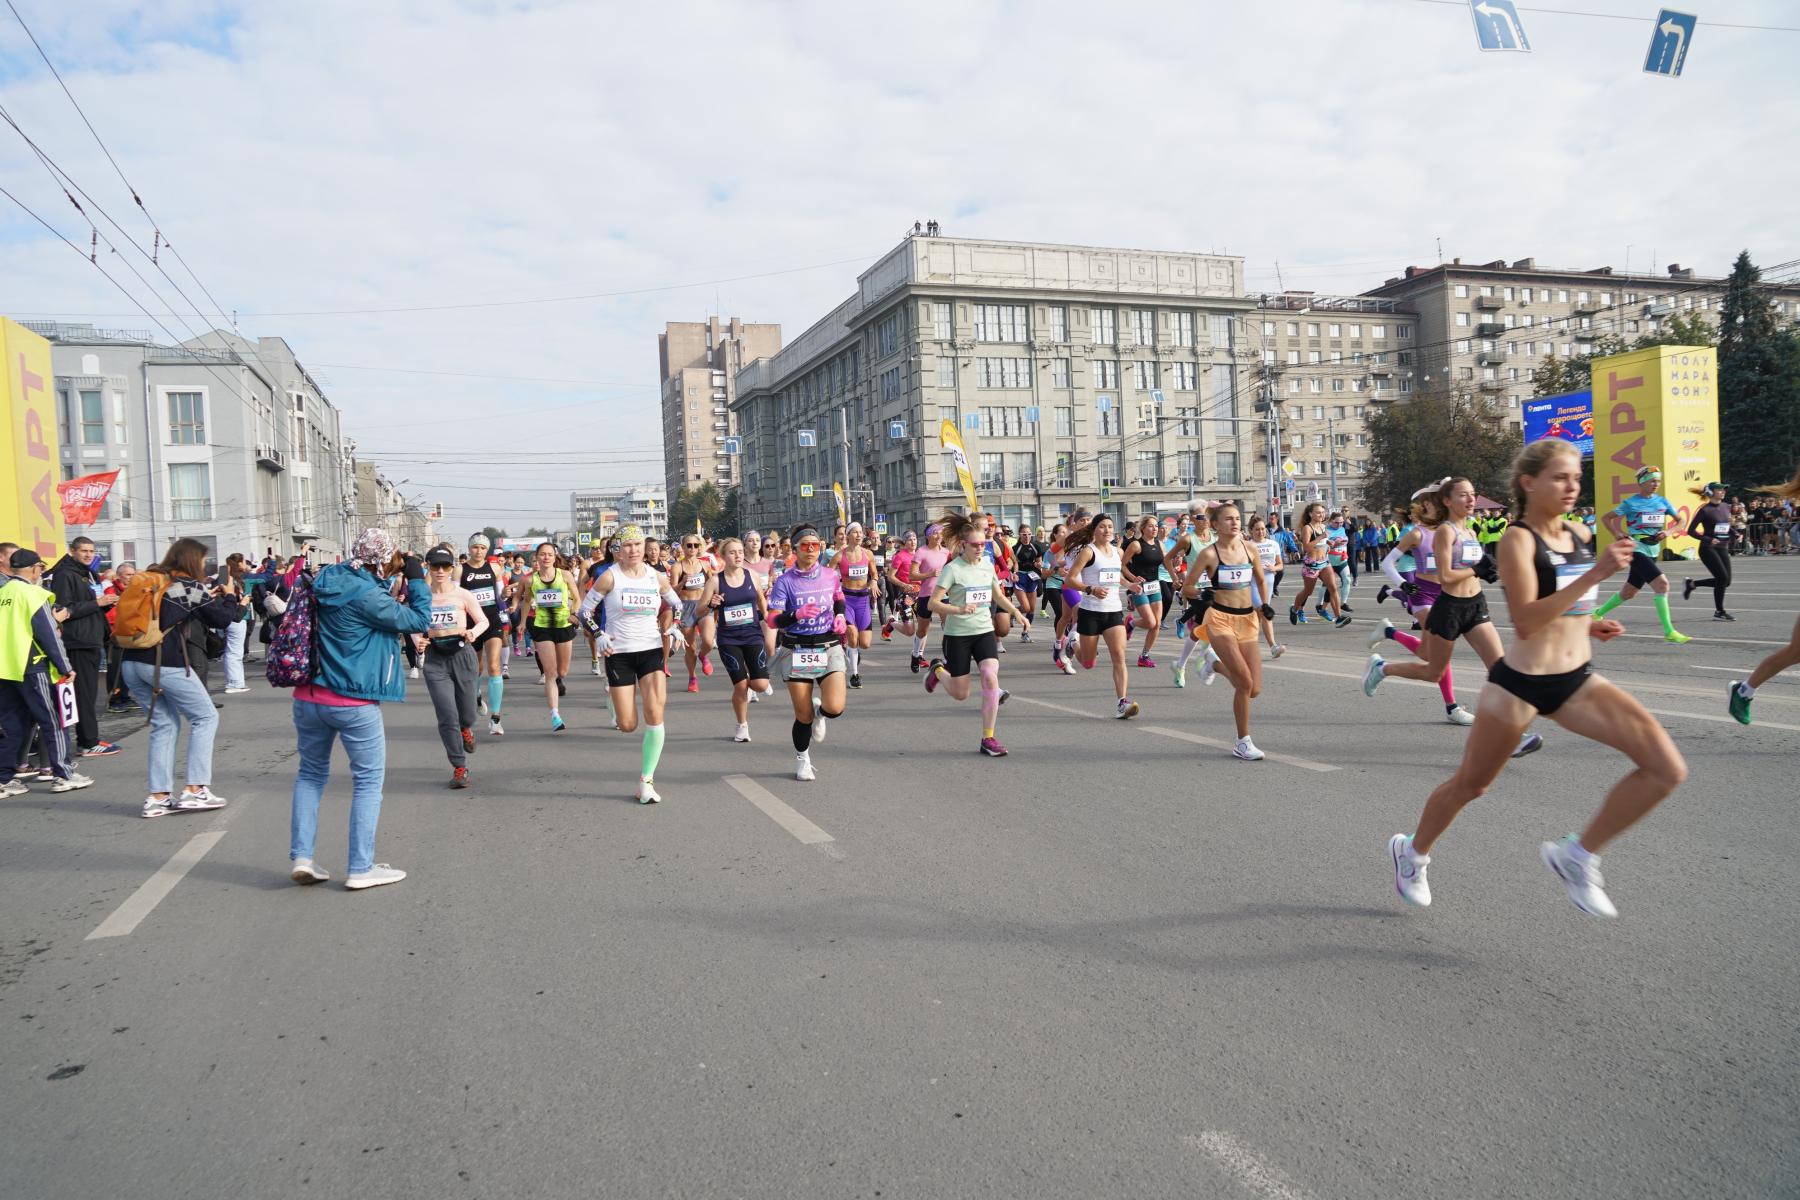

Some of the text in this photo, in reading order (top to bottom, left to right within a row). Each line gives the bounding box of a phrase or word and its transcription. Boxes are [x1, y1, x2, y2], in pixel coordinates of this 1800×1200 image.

[1671, 355, 1709, 366] ПОЛУ
[1230, 571, 1242, 580] 19
[542, 593, 557, 601] 492
[628, 595, 652, 605] 1205
[972, 592, 987, 600] 975
[431, 613, 454, 623] 775
[730, 609, 747, 618] 503
[800, 654, 820, 663] 554
